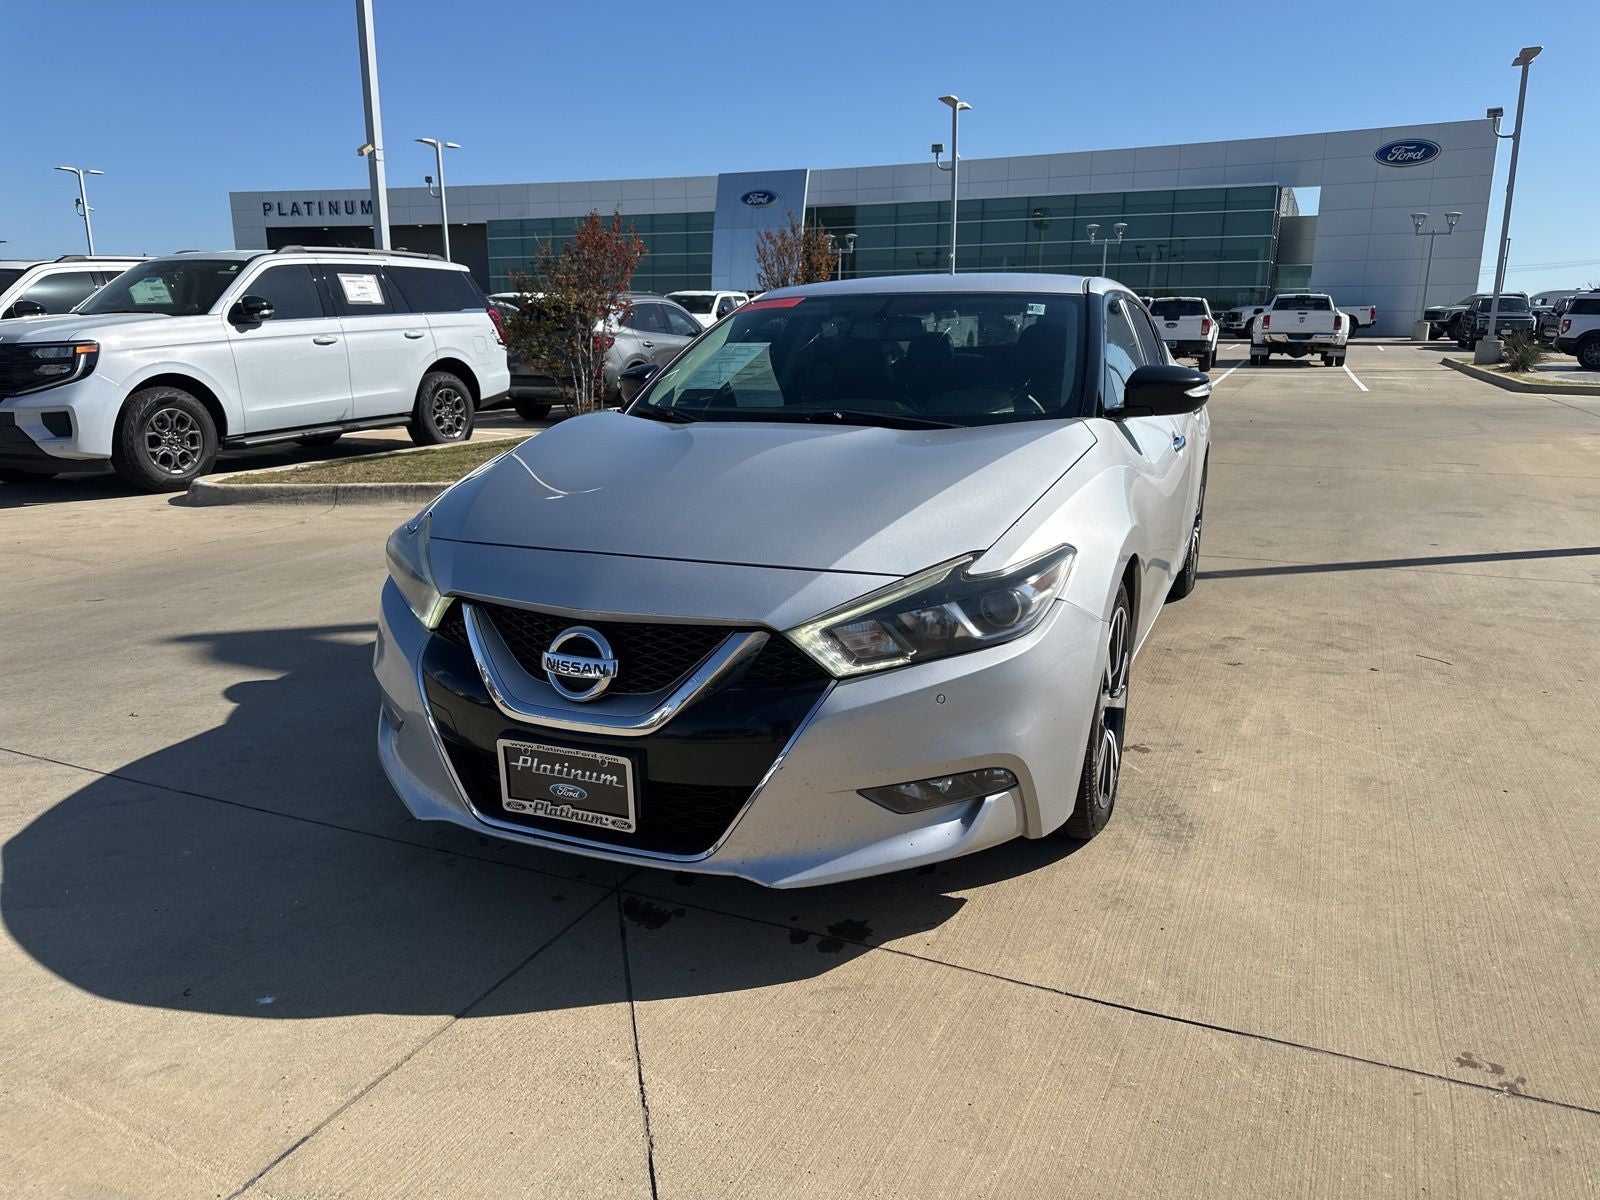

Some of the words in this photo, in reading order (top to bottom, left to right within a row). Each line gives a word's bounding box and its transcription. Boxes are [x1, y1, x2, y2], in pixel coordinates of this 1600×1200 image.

[1387, 145, 1425, 160] Ford
[747, 193, 769, 204] Ford
[262, 200, 374, 217] PLATINUM
[546, 657, 607, 675] NISSAN
[510, 742, 619, 763] www.PlatinumFord.com
[510, 755, 625, 788] Platinum
[556, 785, 580, 798] Ford
[533, 801, 608, 825] Platinum
